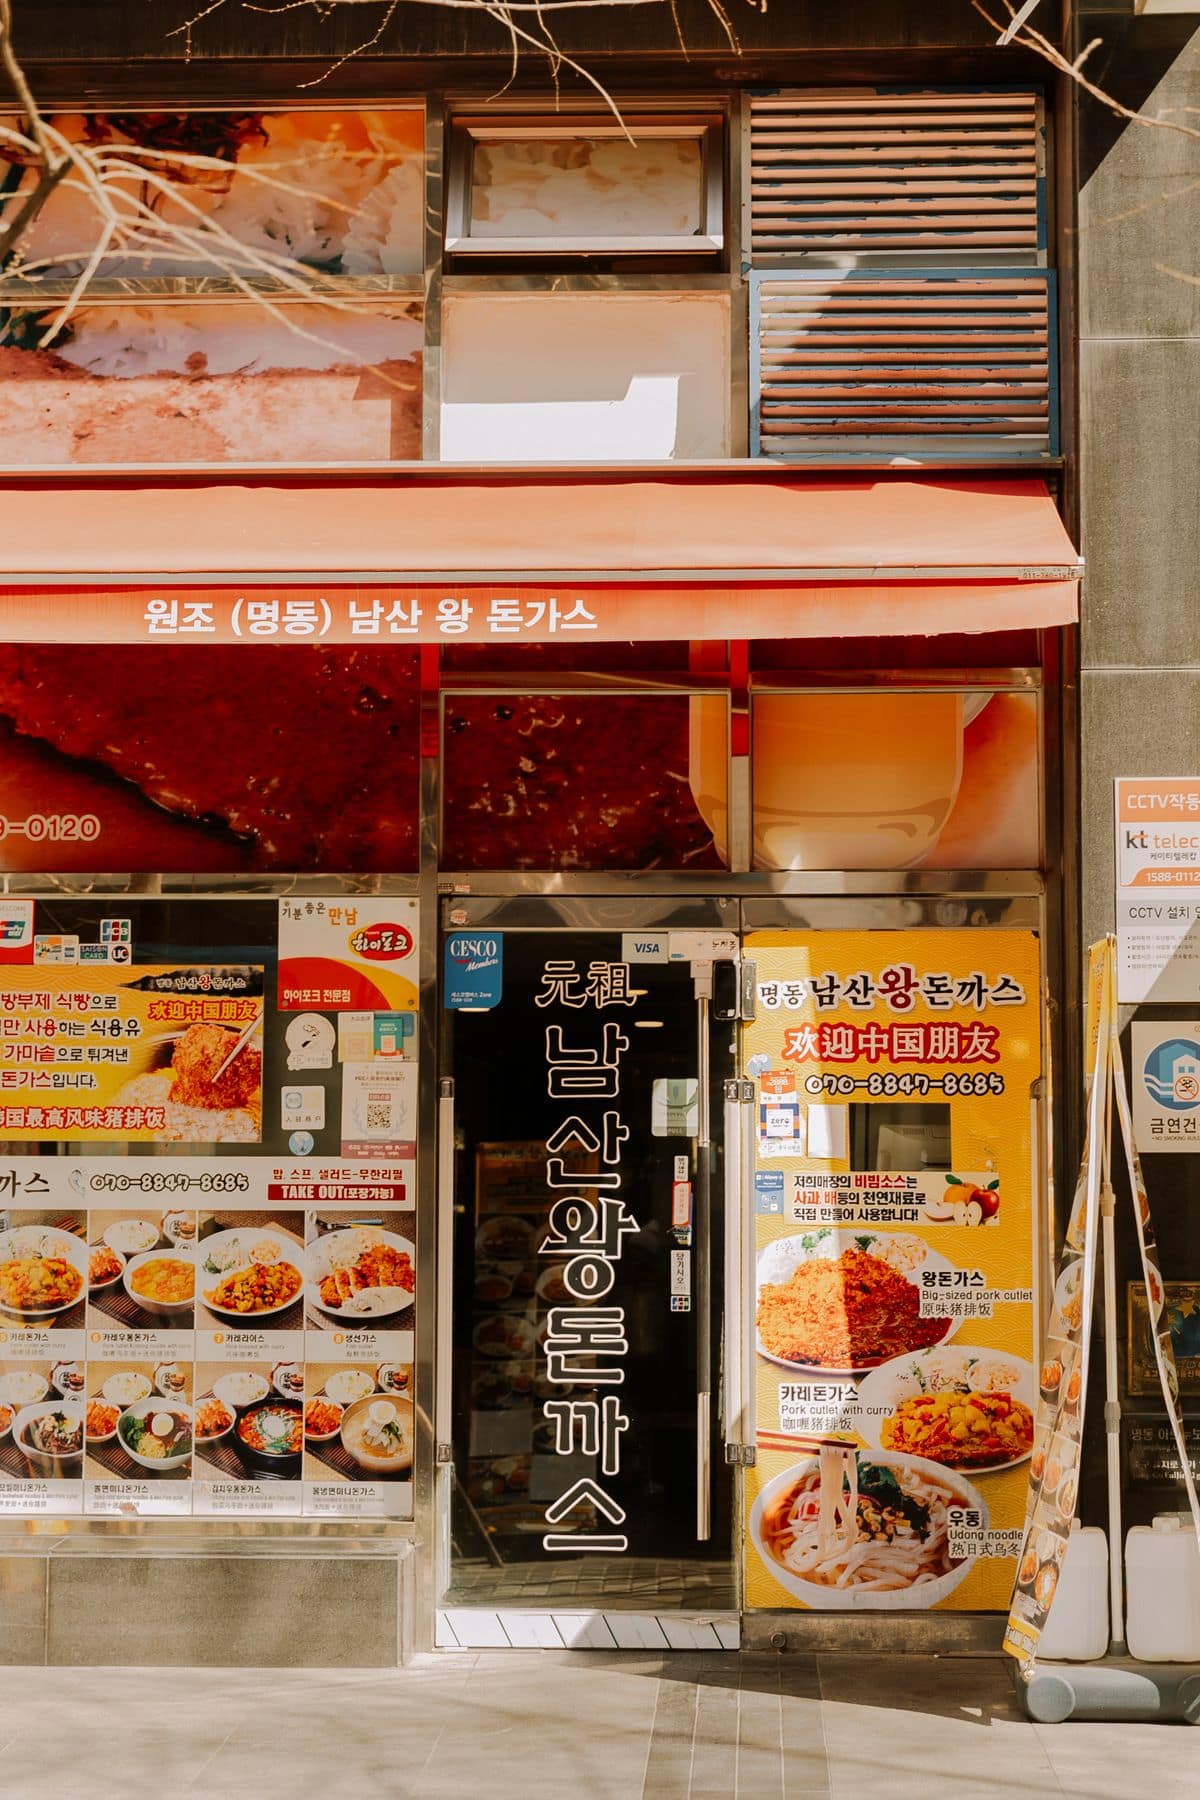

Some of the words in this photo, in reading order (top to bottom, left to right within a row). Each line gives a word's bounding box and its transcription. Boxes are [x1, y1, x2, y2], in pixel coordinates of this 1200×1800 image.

[144, 598, 215, 634] 원조
[231, 598, 333, 636] (명동)
[349, 598, 421, 634] 남산
[435, 598, 473, 634] 왕
[486, 598, 598, 633] 돈가스
[1126, 830, 1148, 848] kt
[1153, 832, 1199, 848] telec
[282, 908, 303, 920] 기분
[305, 902, 326, 914] 좋은
[329, 908, 358, 926] 만남
[1129, 907, 1162, 919] CCTV
[1167, 906, 1190, 919] 설치
[102, 921, 129, 942] JCB
[351, 931, 408, 952] 하이포크
[450, 940, 497, 957] CESCO
[634, 943, 660, 953] VISA
[113, 948, 129, 957] UC
[465, 957, 499, 973] Members
[535, 960, 637, 1008] 元祖
[760, 983, 803, 1006] 명동
[809, 966, 1023, 1009] 남산왕돈까스
[57, 993, 117, 1010] 식빵으로
[283, 989, 320, 1003] 하이포크
[323, 989, 351, 1003] 전문점
[149, 1000, 257, 1020] 欢迎中国朋友
[0, 1019, 20, 1036] 만
[25, 1019, 85, 1037] 사용하는
[91, 1019, 141, 1037] 식용유
[784, 1025, 997, 1061] 欢迎中国朋友
[5, 1045, 83, 1062] 가마솥으로
[88, 1048, 128, 1062] 튀겨낸
[1, 1071, 97, 1088] 돈가스입니다.
[805, 1072, 1005, 1096] 070-8847-8685
[1150, 1117, 1200, 1134] 금연건
[90, 1173, 249, 1191] 070-8847-8685
[794, 1175, 851, 1188] 저희매장의
[854, 1174, 918, 1189] 비빔소스는
[281, 1186, 314, 1199] TAKE
[824, 1191, 860, 1205] 배등의
[863, 1191, 927, 1205] 천연재료로
[794, 1208, 816, 1221] 직접
[820, 1208, 854, 1221] 만들어
[857, 1208, 919, 1221] 사용합니다!
[922, 1271, 984, 1287] 왕돈가스
[538, 1023, 640, 1552] 남산왕돈까스
[922, 1290, 973, 1301] Big-sized
[976, 1290, 1000, 1301] pork
[1003, 1290, 1033, 1301] cutlet
[922, 1302, 992, 1316] 原味猪排饭
[10, 1333, 49, 1342] 카레돈가스
[103, 1333, 157, 1342] 카레우동돈가스
[225, 1334, 265, 1343] 카레라이스
[345, 1334, 376, 1343] 생선가스
[781, 1386, 859, 1402] 카레돈가스
[781, 1405, 806, 1415] Pork
[810, 1405, 838, 1415] cutlet
[843, 1405, 863, 1415] with
[866, 1407, 894, 1417] curry
[212, 1484, 261, 1494] 김치우동돈가스
[950, 1511, 980, 1527] 우동
[950, 1530, 985, 1541] Udong
[988, 1530, 1024, 1540] noodle
[951, 1542, 1021, 1557] 热日式乌冬
